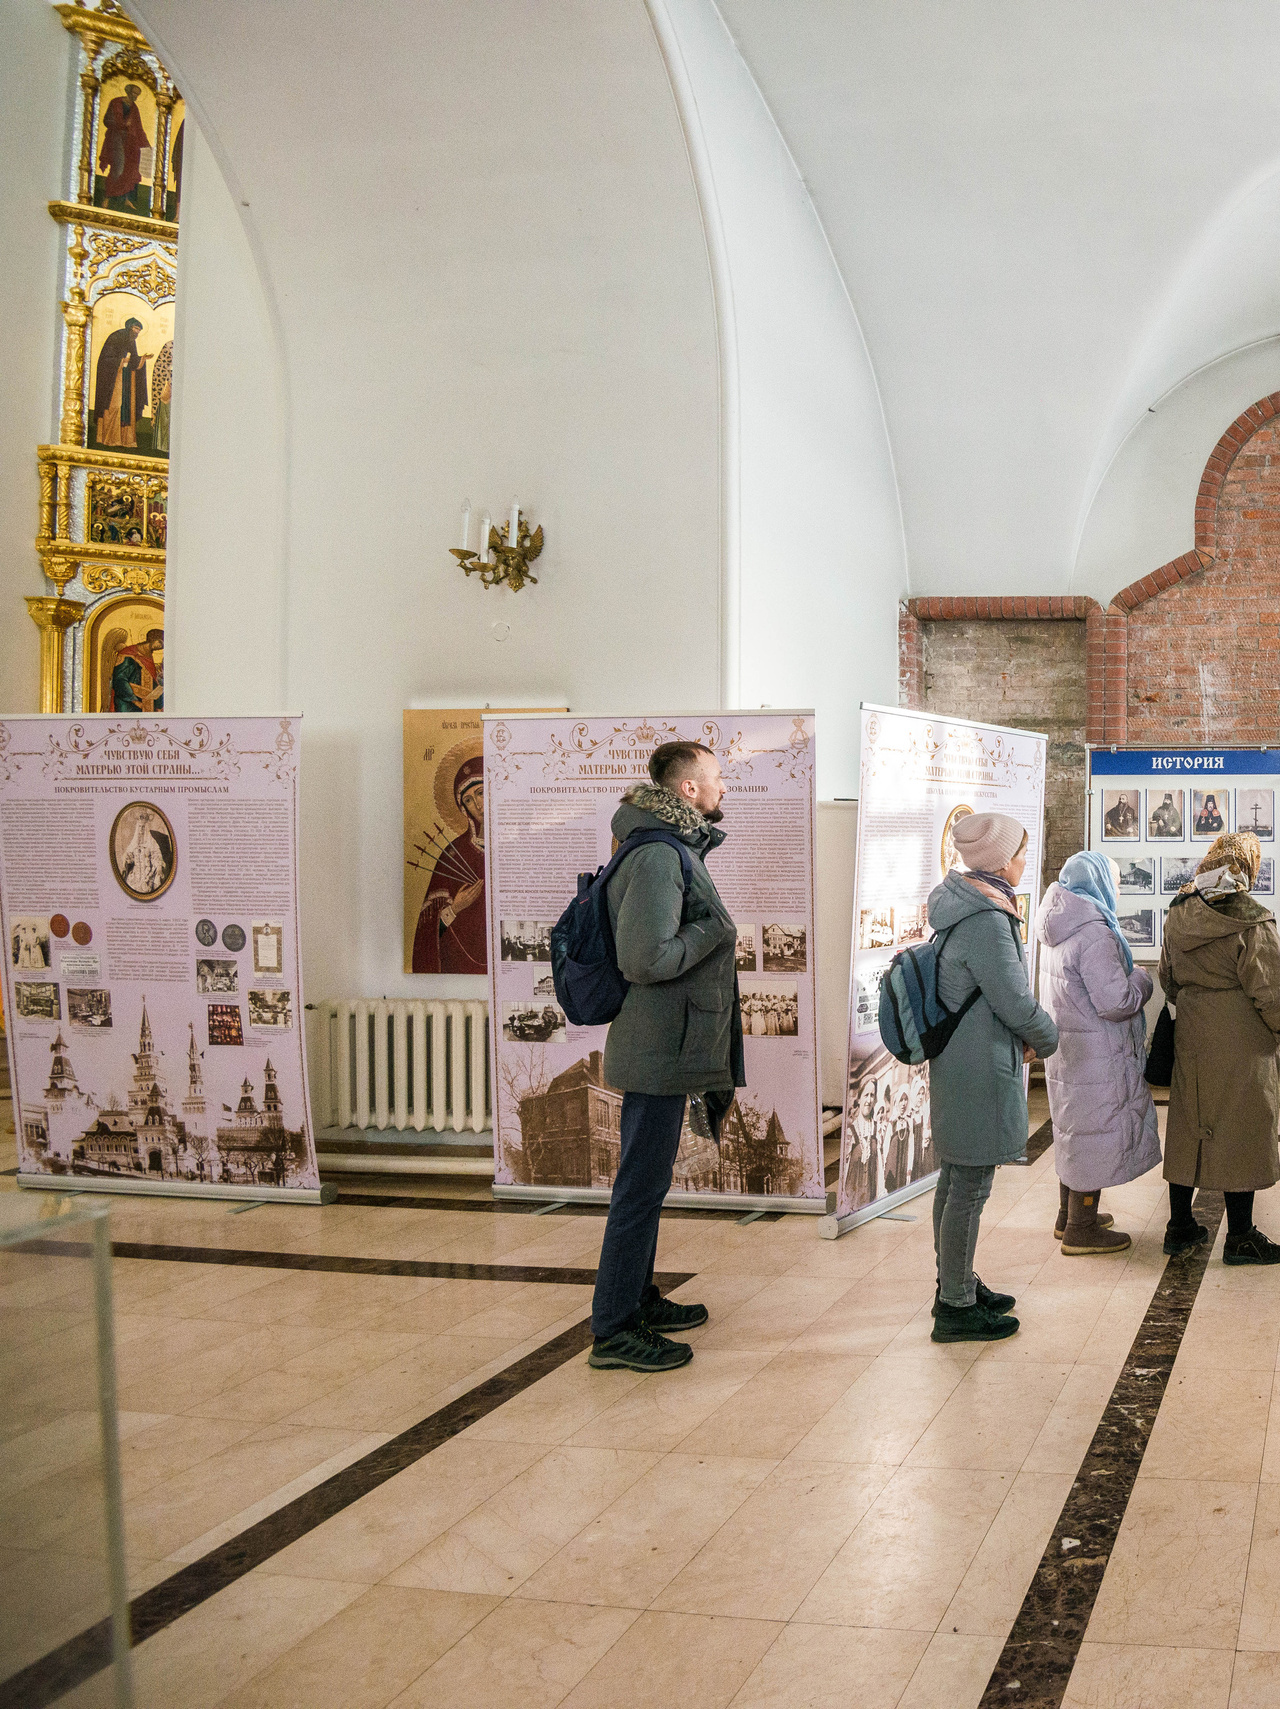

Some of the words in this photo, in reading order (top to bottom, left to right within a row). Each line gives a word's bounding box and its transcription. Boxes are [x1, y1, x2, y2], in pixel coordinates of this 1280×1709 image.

[156, 750, 180, 760] СЕБЯ
[1151, 756, 1224, 769] ИСТОРИЯ
[76, 764, 122, 775] МАТЕРЬЮ
[126, 763, 149, 775] ЭТОЙ
[579, 764, 627, 775] МАТЕРЬЮ
[630, 764, 650, 774] ЭТО
[530, 786, 608, 794] ПОКРОВИТЕЛЬСТВО
